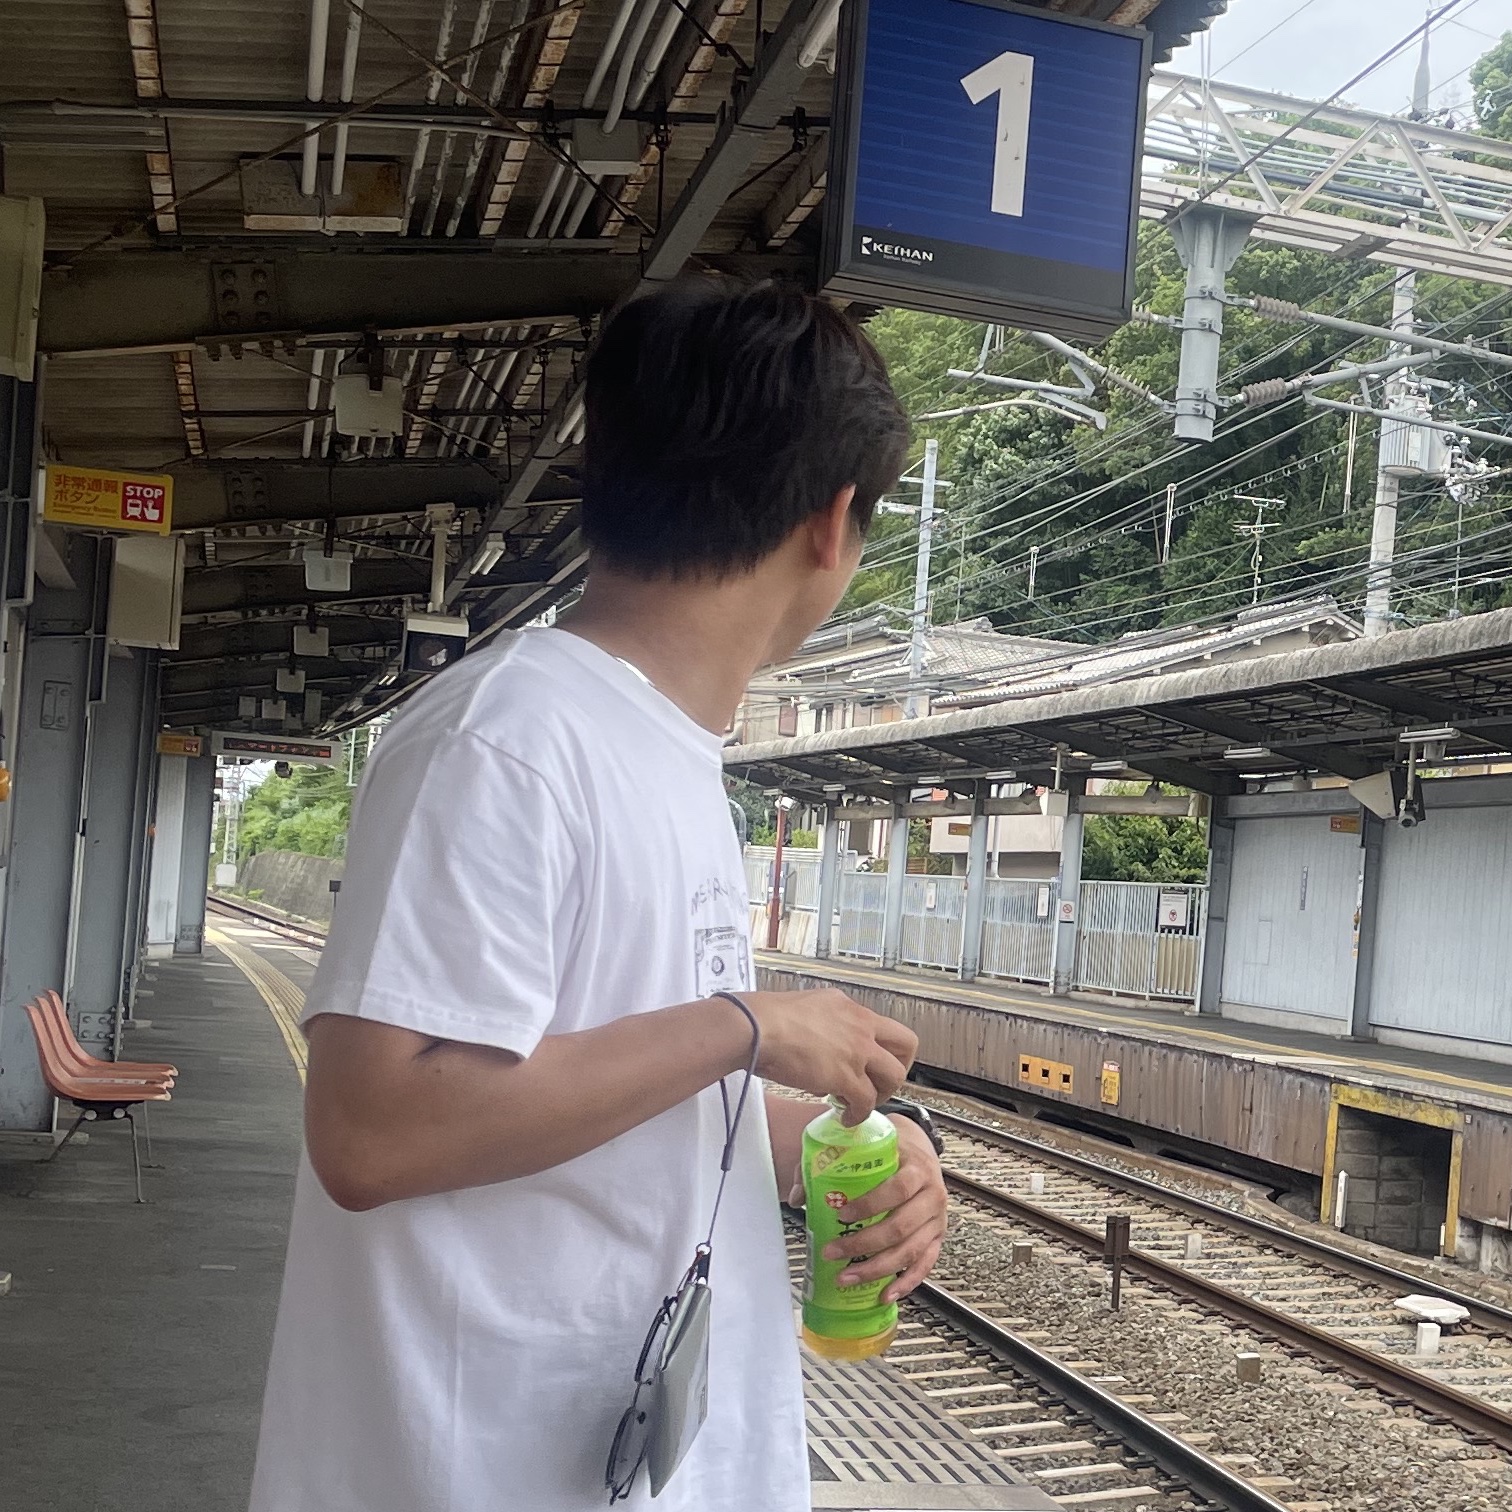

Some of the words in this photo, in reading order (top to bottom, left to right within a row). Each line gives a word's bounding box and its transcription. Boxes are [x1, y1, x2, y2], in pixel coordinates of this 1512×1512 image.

[960, 51, 1034, 217] 1
[873, 242, 934, 262] KEIHAN
[54, 474, 118, 494] 非常通報
[125, 485, 163, 499] STOP
[53, 489, 100, 504] ボタン
